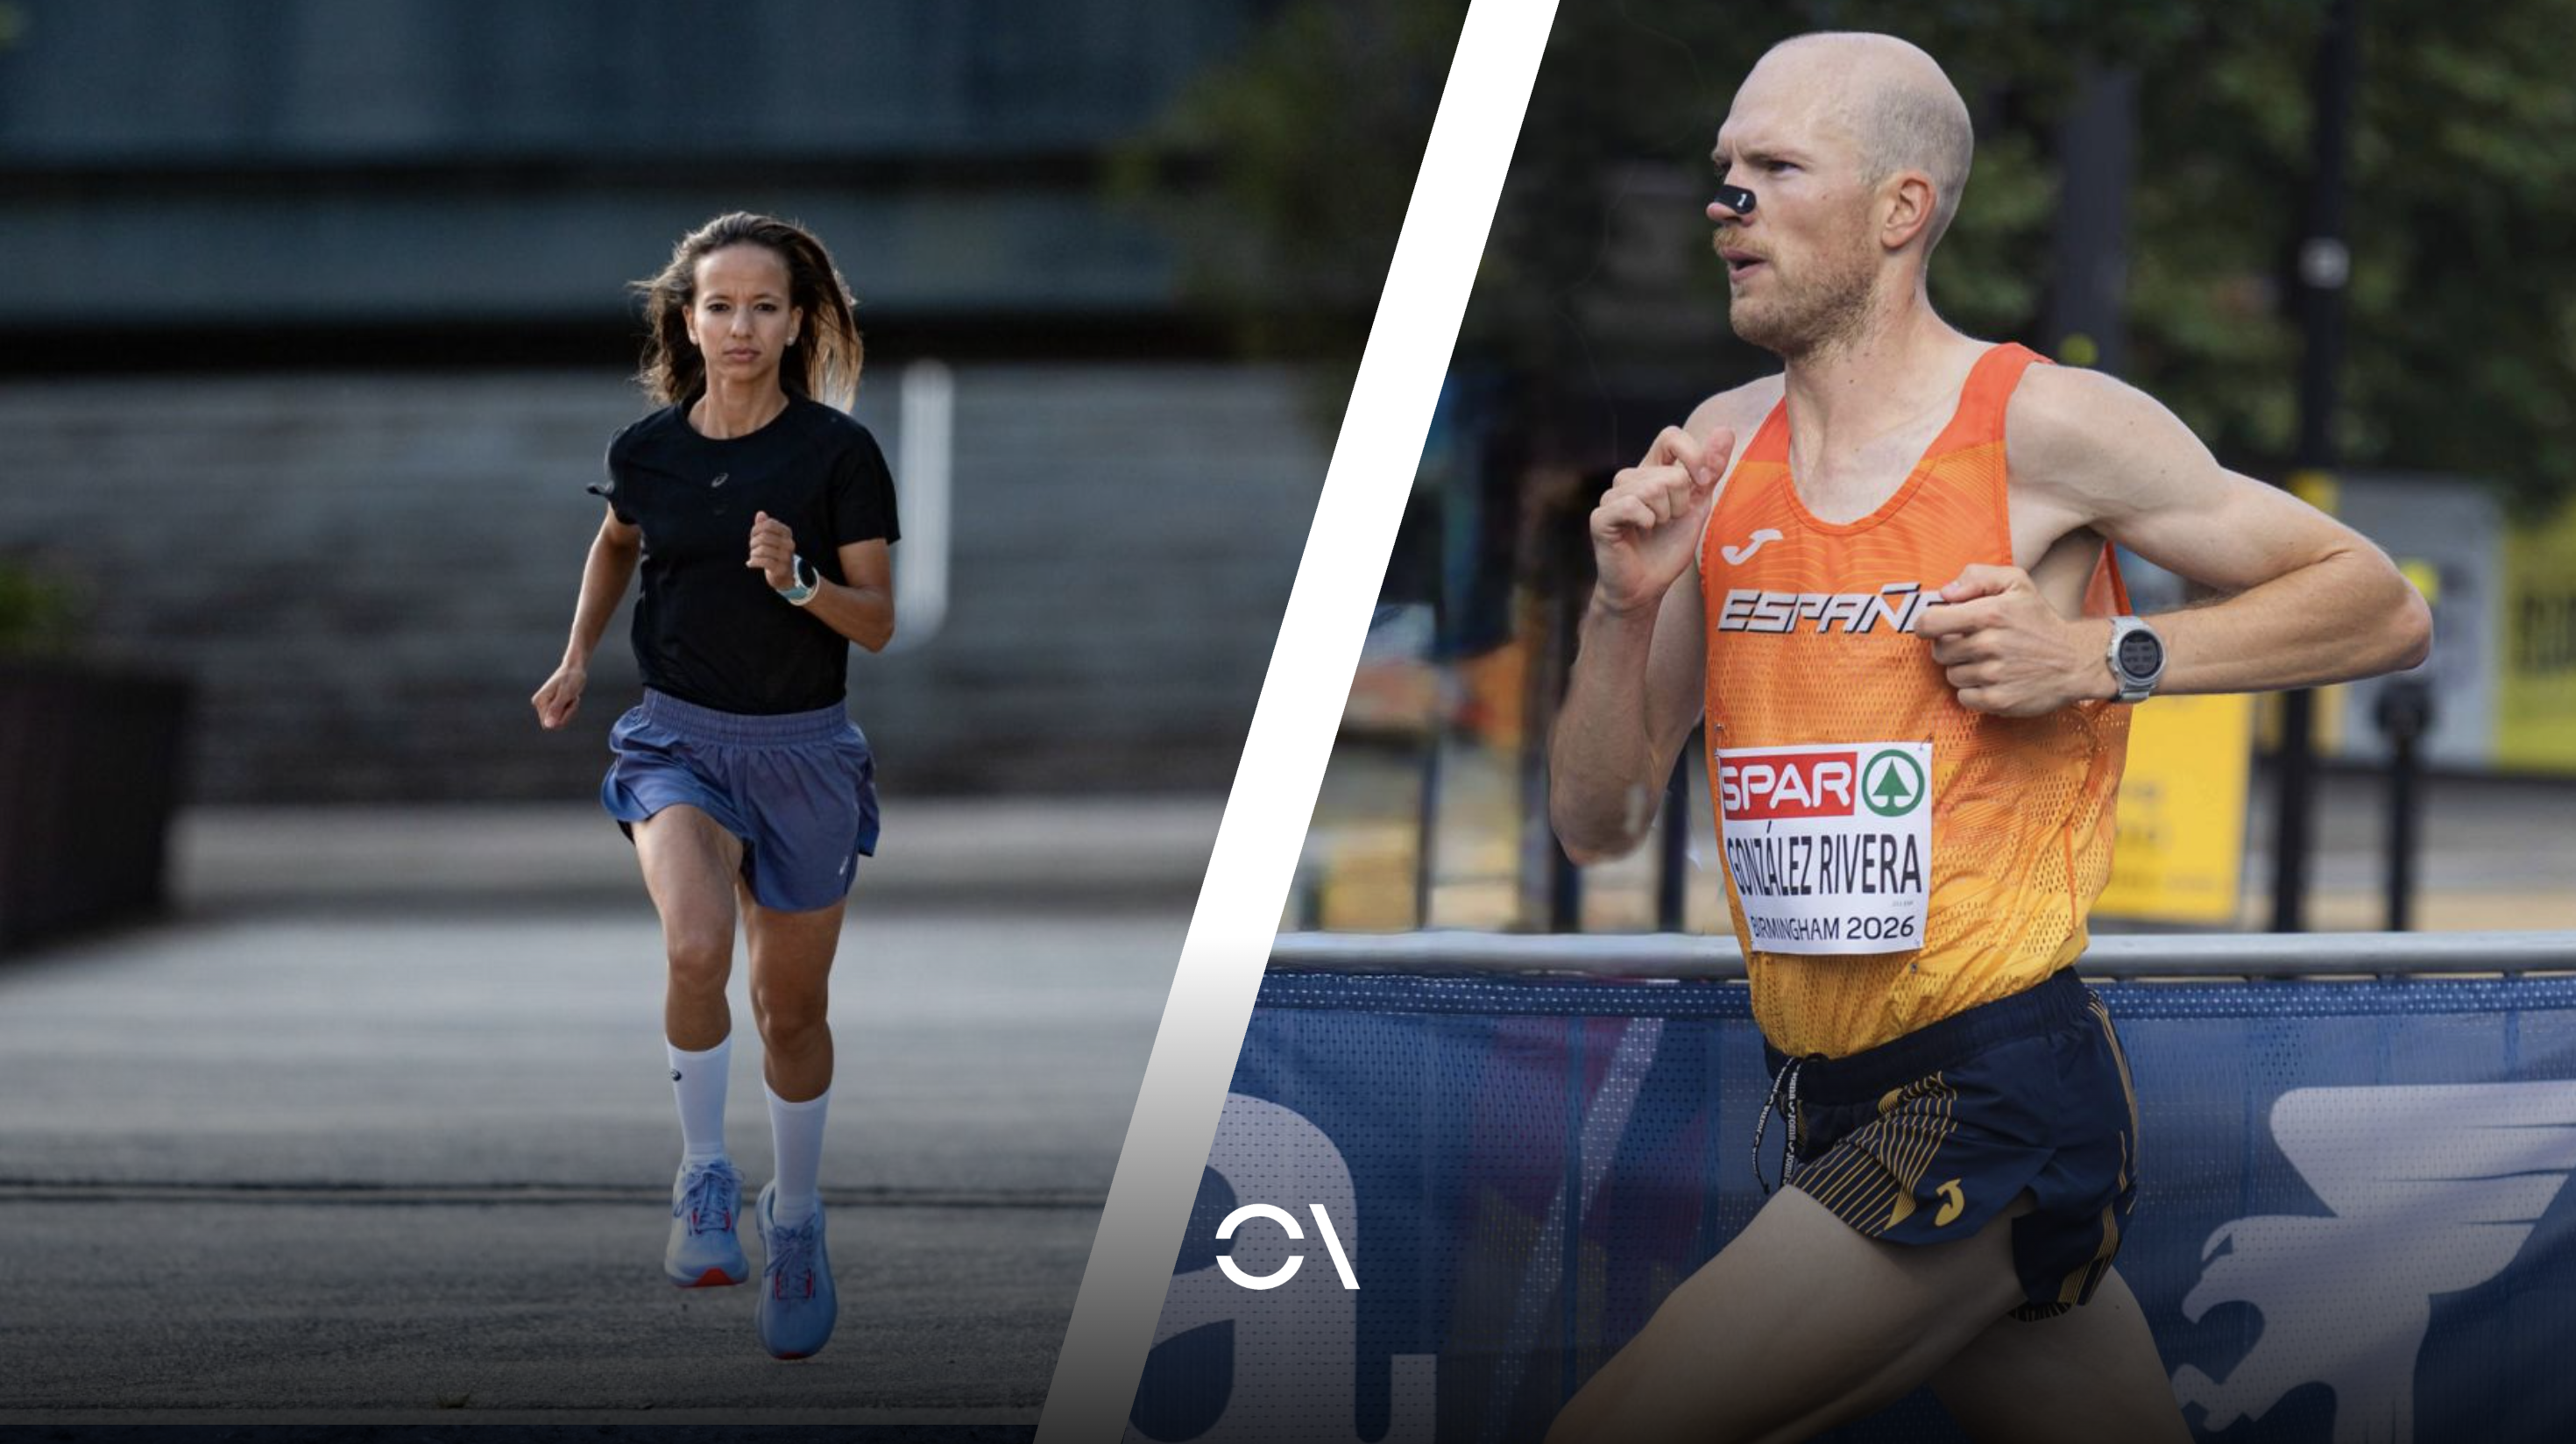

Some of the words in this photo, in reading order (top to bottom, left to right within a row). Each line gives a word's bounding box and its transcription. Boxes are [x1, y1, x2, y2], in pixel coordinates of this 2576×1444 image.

[1720, 761, 1853, 811] SPAR
[1726, 820, 1813, 896] GONZÁLEZ
[1819, 833, 1922, 895] RIVERA
[1846, 915, 1915, 941] 2026
